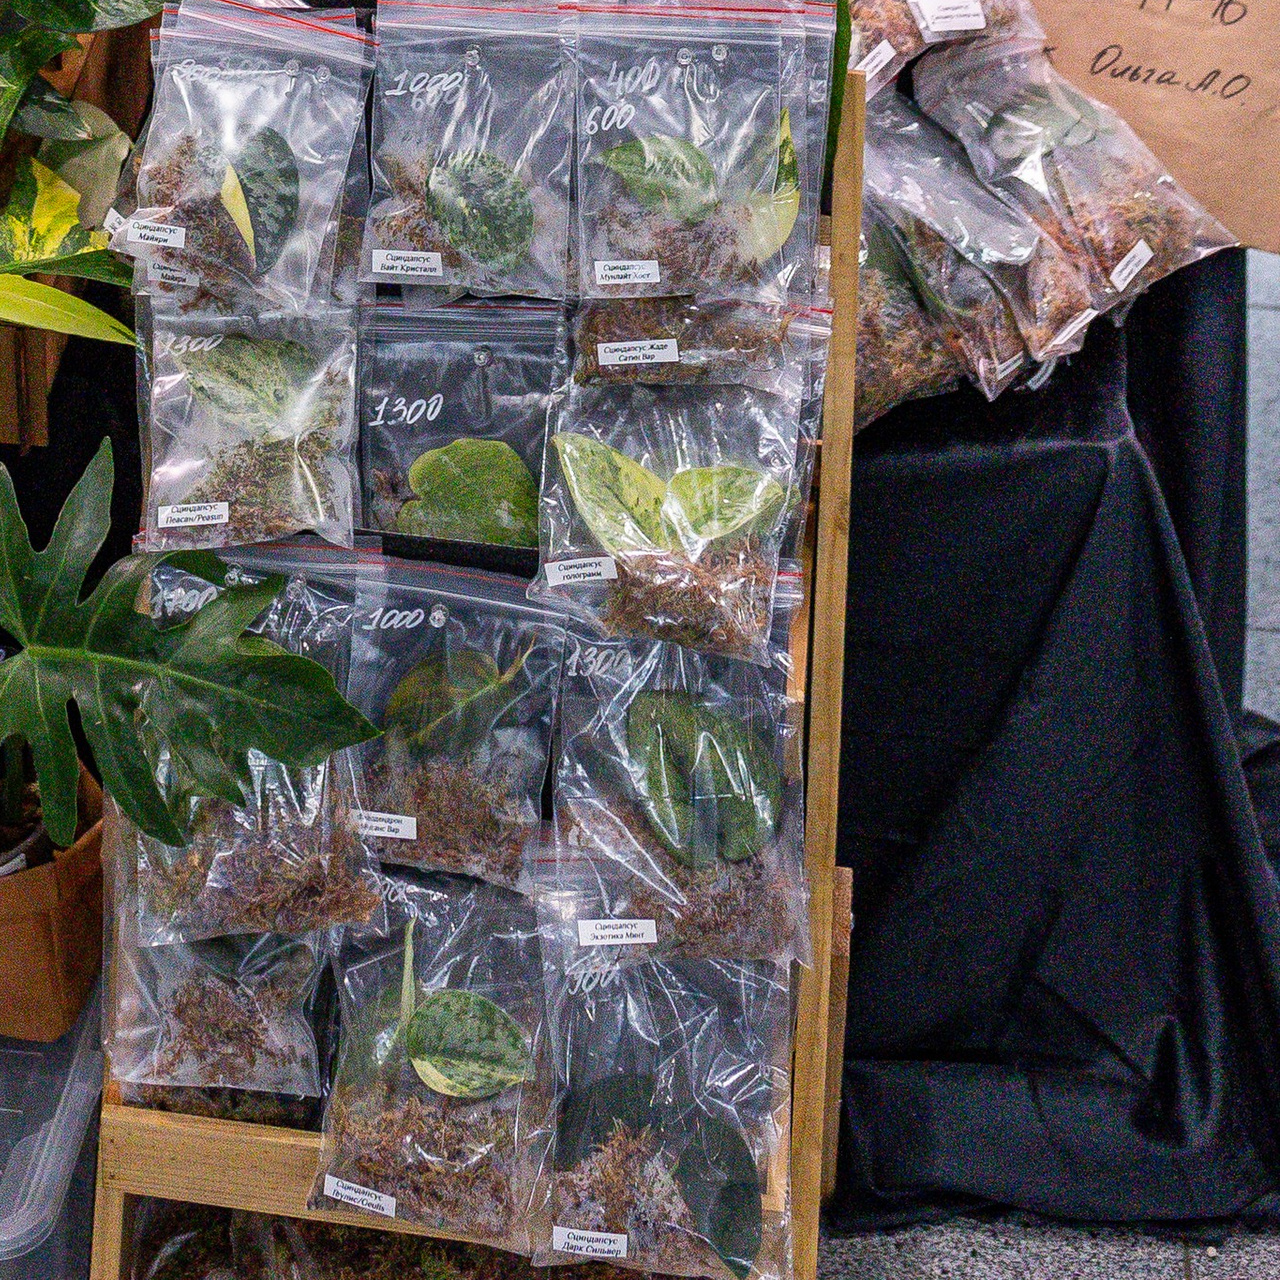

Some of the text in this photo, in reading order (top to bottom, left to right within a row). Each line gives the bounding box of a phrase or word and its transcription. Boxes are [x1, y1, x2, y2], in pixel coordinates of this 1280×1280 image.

[1090, 44, 1180, 85] Ольга
[384, 69, 465, 96] 1000
[585, 104, 636, 135] 600
[385, 252, 431, 264] Сциндапсус
[369, 393, 444, 426] 1300
[557, 560, 603, 573] Сциндапсус
[362, 608, 426, 631] 1000
[566, 1231, 618, 1246] Сциндапсус
